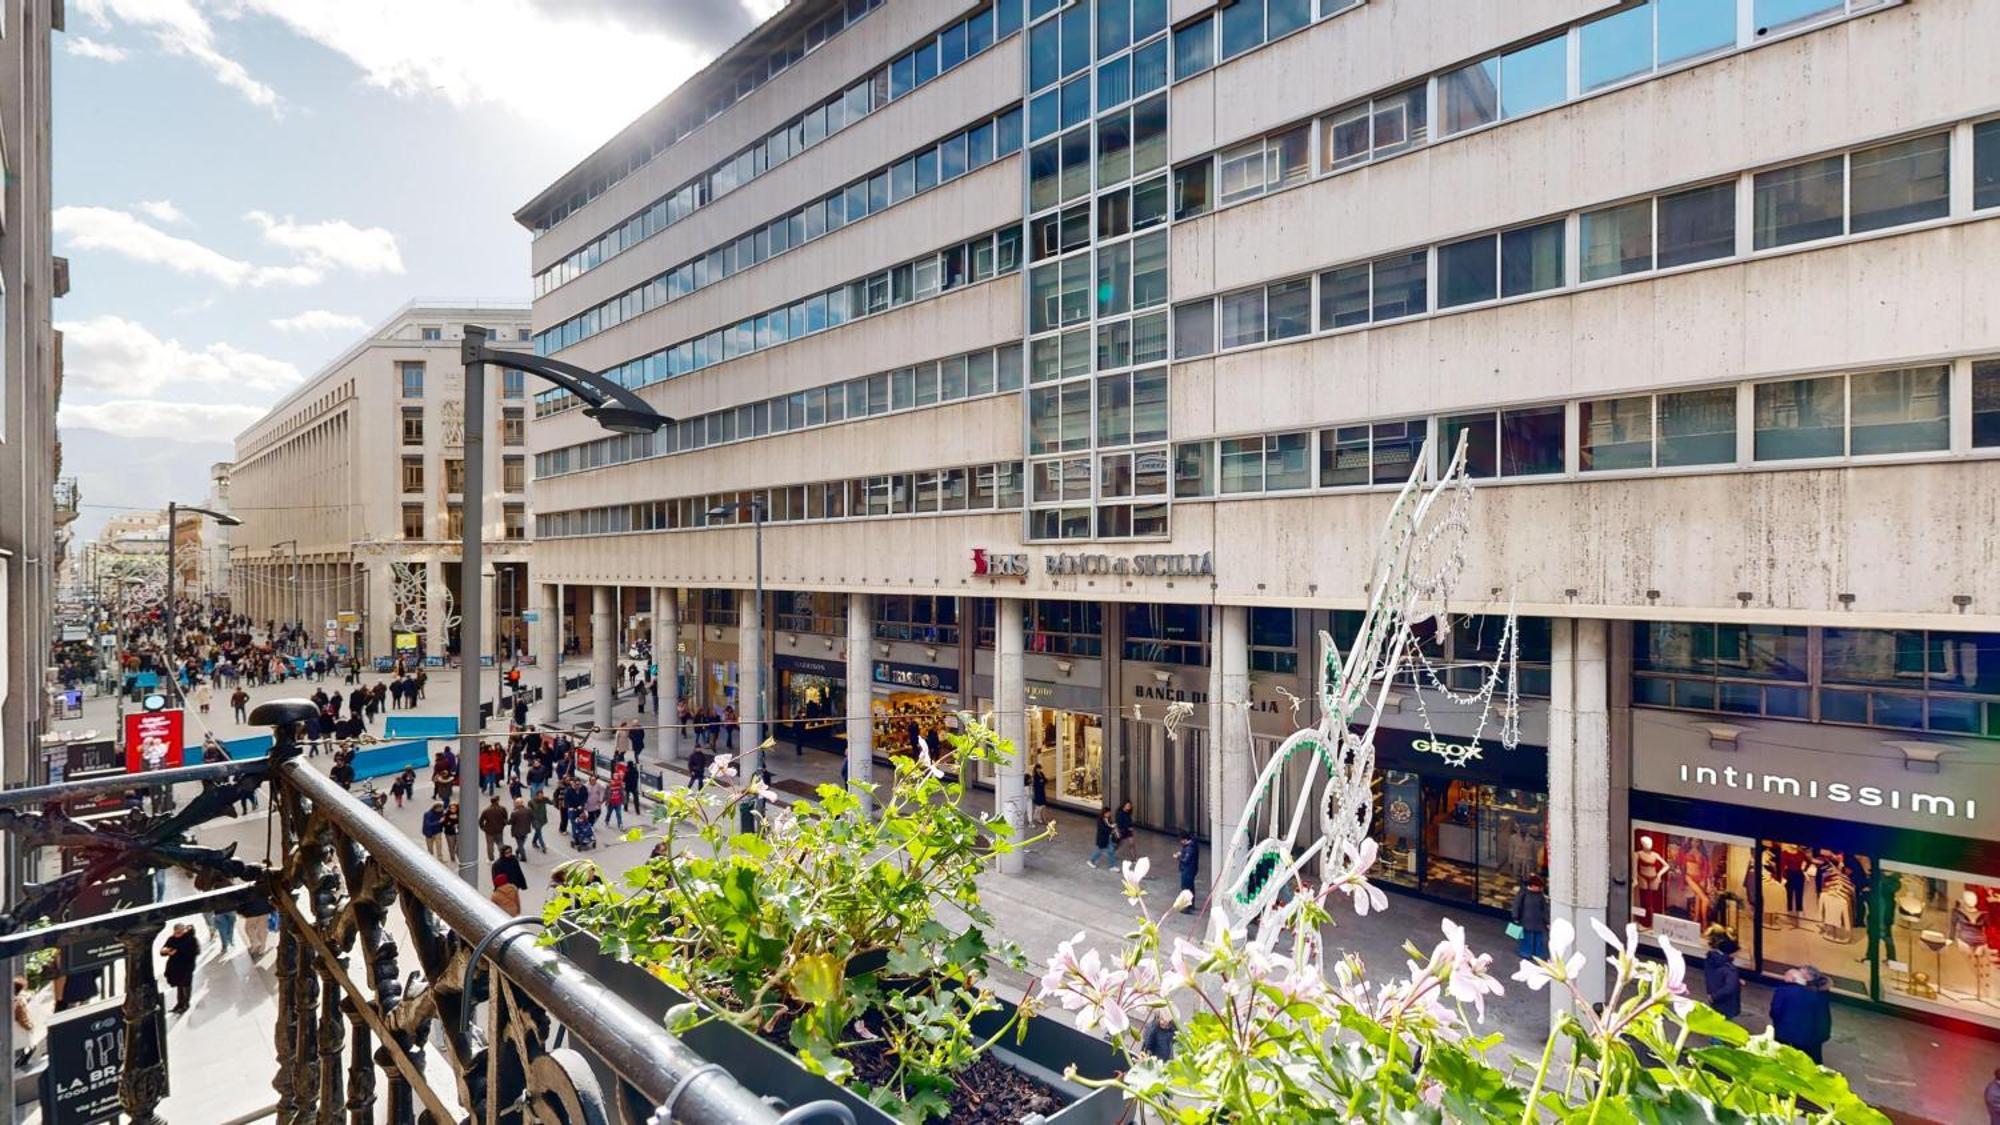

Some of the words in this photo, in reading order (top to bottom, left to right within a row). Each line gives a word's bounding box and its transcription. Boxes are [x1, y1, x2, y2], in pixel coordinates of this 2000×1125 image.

[1045, 552, 1108, 576] BANCO
[1132, 551, 1214, 577] SICILIA
[1135, 685, 1185, 702] BANCO
[1191, 690, 1208, 704] DI
[1411, 739, 1484, 759] GEOX
[1680, 765, 1976, 820] intimissimi
[56, 1077, 84, 1094] LA
[57, 1085, 89, 1101] FOOD
